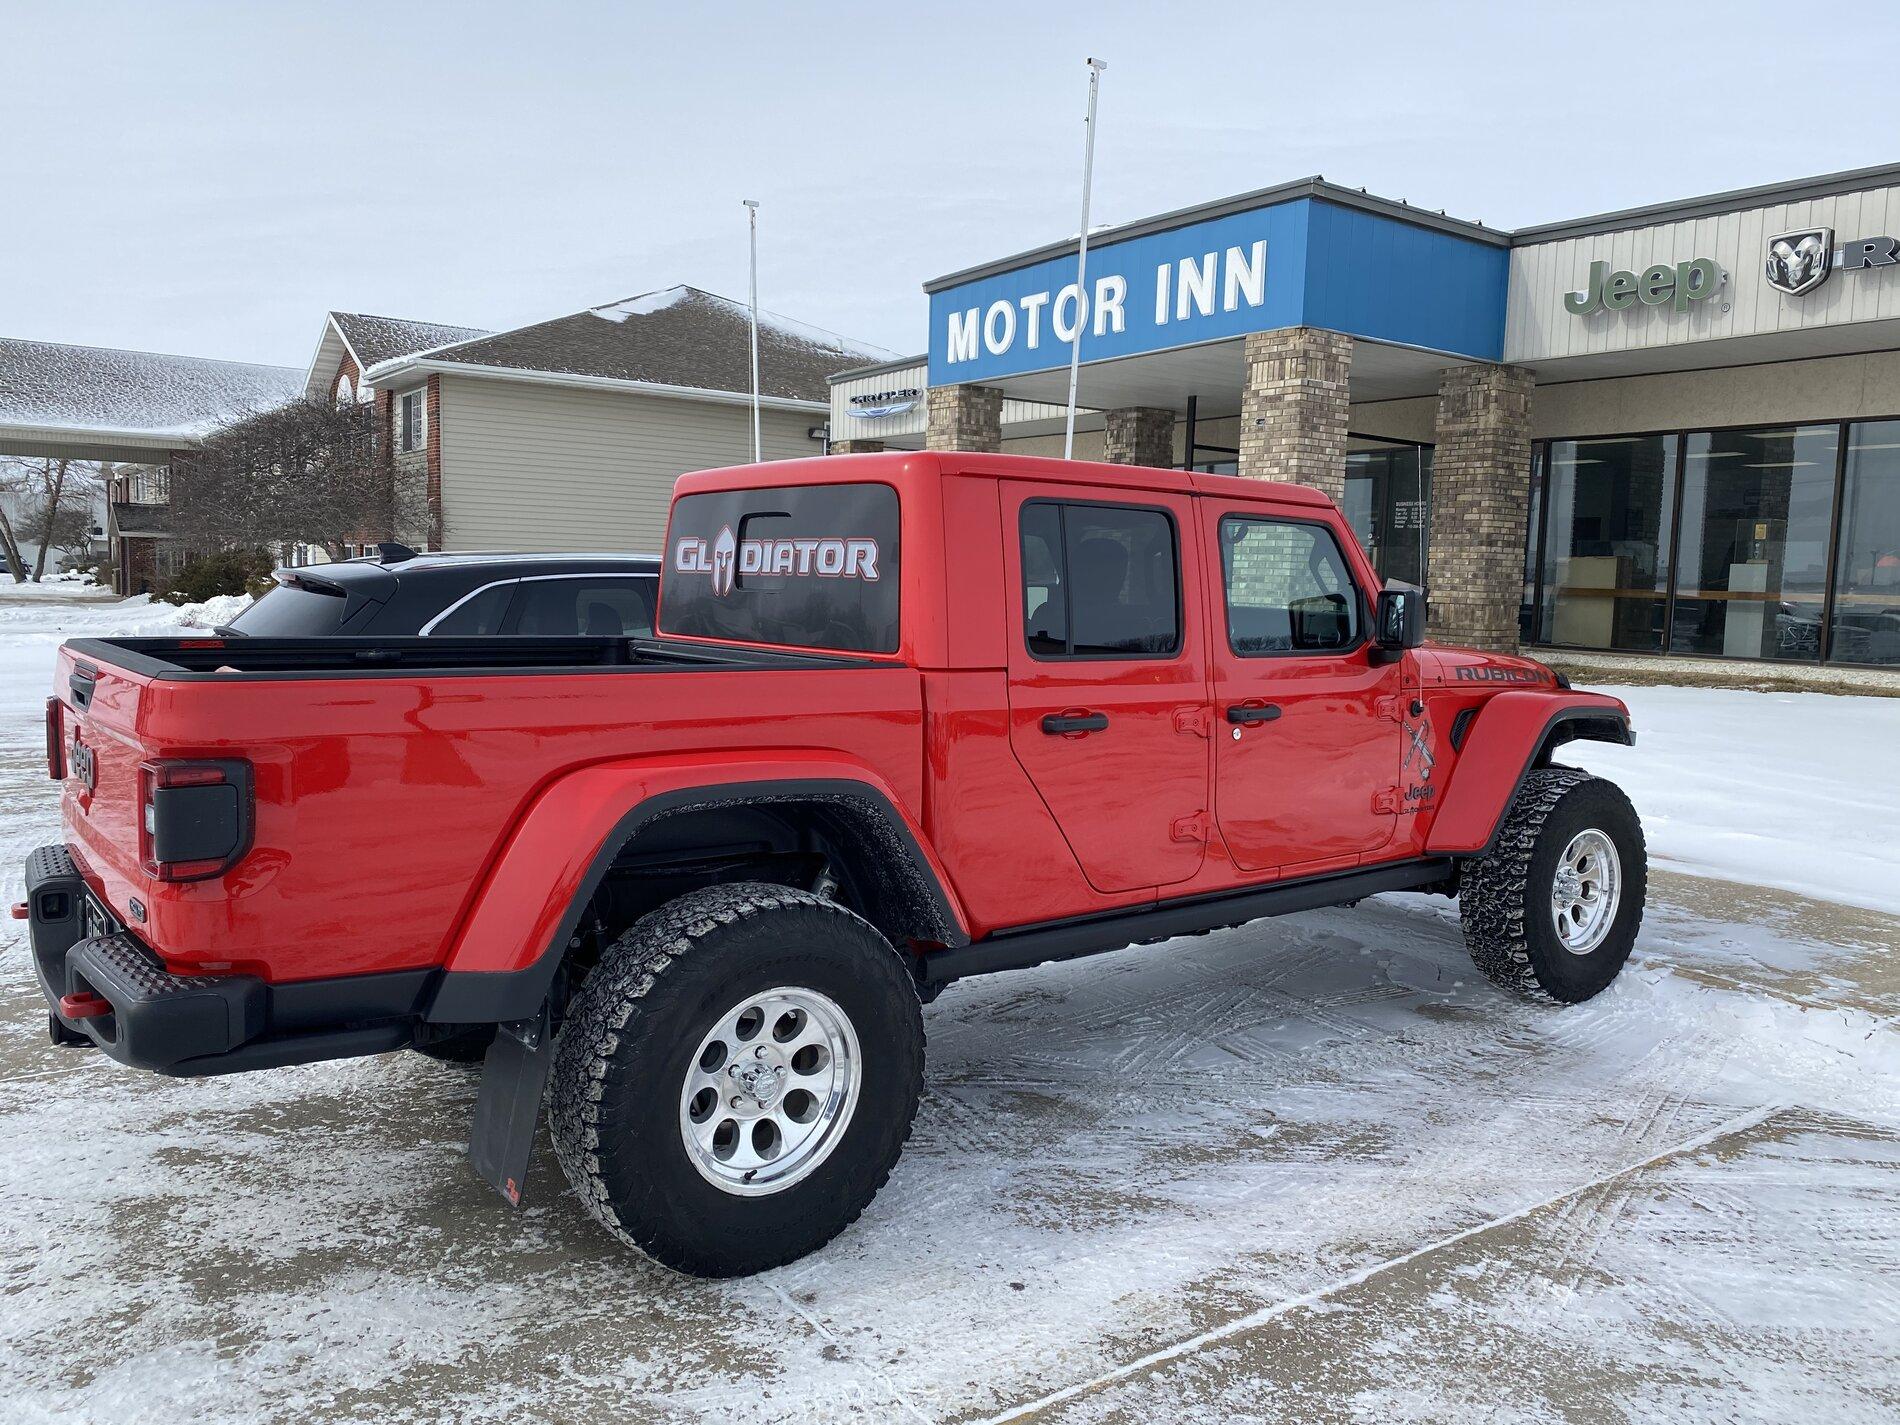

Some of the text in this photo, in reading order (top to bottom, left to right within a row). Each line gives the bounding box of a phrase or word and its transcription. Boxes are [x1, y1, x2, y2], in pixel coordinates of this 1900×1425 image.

[947, 239, 1267, 364] MOTOR INN
[1563, 257, 1723, 315] Jeep
[1456, 666, 1550, 683] RUBICON
[1404, 783, 1435, 801] Jeep
